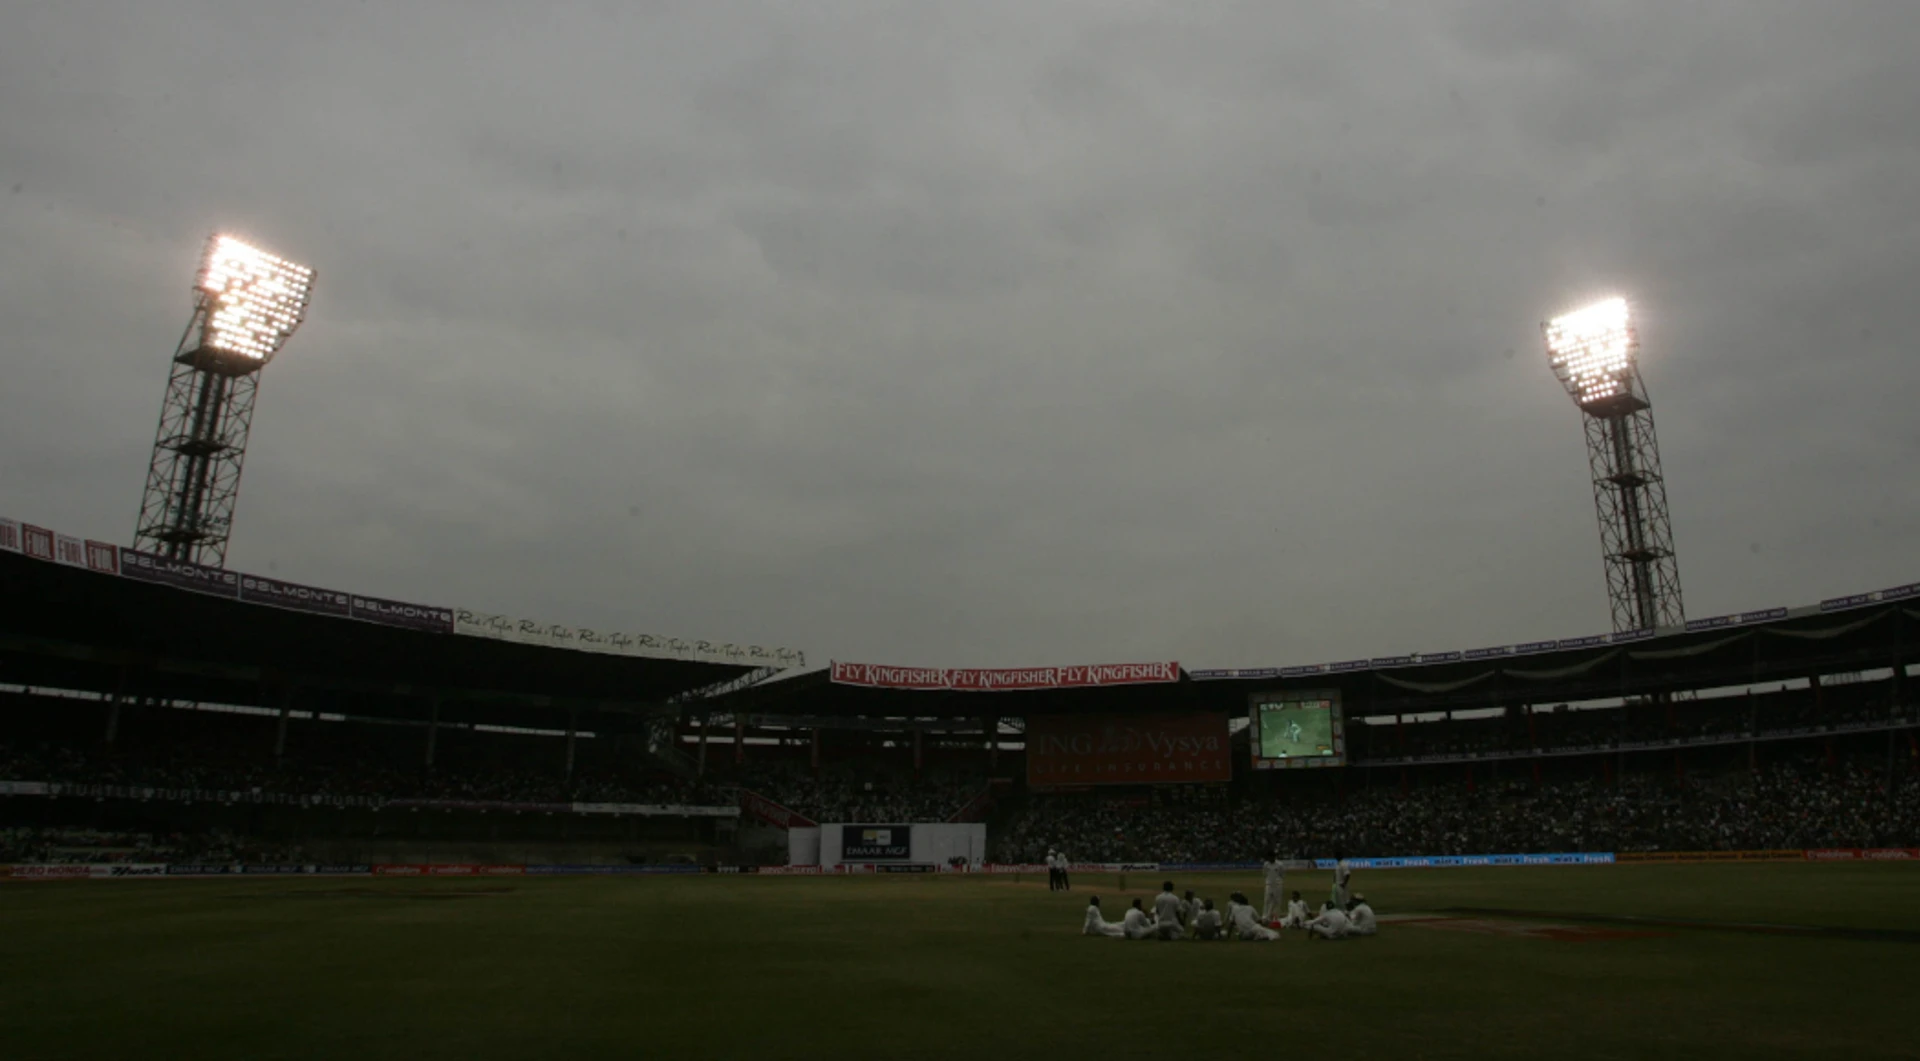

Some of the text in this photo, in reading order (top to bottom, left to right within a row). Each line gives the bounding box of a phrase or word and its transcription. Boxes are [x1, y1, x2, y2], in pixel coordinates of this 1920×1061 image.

[123, 552, 237, 585] BELMONTE
[243, 578, 348, 605] BELMONTE
[354, 599, 452, 624] BELMONTE
[835, 662, 951, 688] FLY KINGFISHER
[953, 669, 1058, 688] FLY KINGFISHER
[1058, 662, 1175, 685] FLY KINGFISHER
[1040, 731, 1220, 759] ING Vysya
[1036, 760, 1222, 775] LIFE INSURANCE
[846, 846, 907, 856] EMAAR MGF
[47, 866, 90, 876] HONDA
